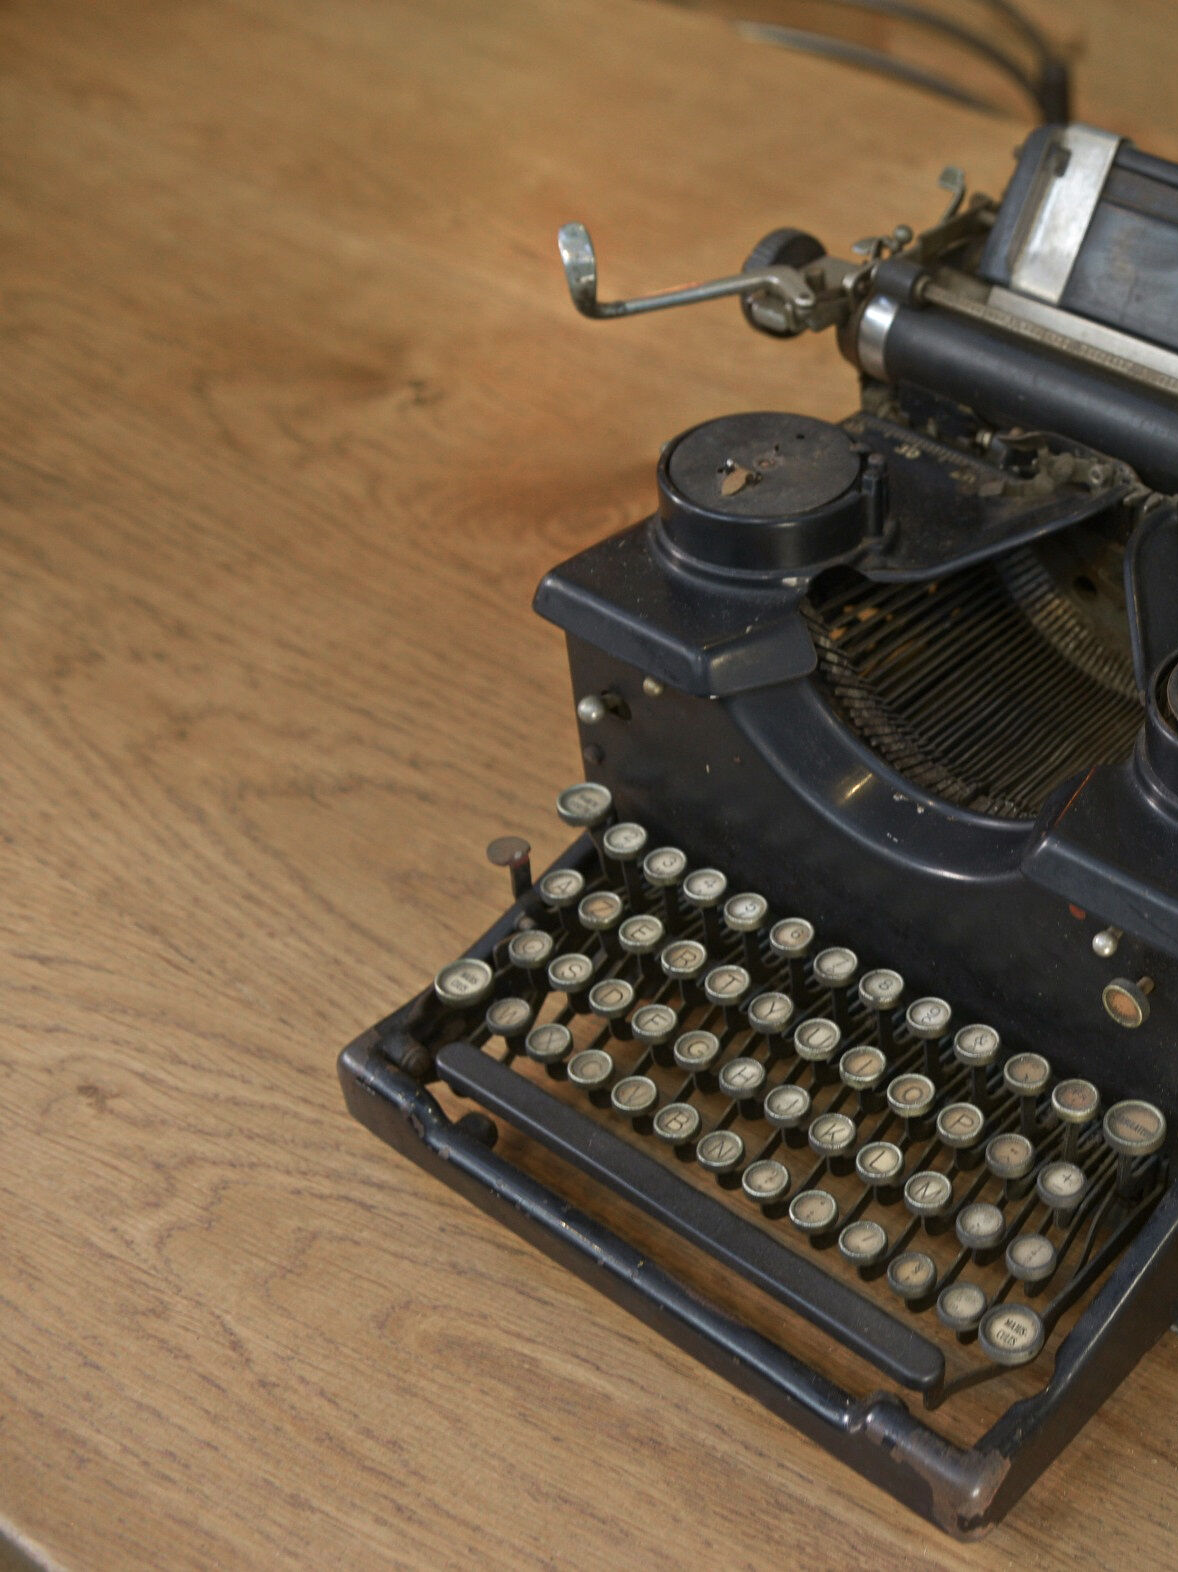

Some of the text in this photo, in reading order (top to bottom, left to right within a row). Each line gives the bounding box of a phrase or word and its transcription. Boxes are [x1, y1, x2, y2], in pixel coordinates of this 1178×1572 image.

[552, 878, 573, 894] A
[630, 923, 655, 940] E
[672, 948, 697, 968] R
[560, 963, 582, 979] S
[718, 973, 742, 993] T
[597, 986, 623, 1006] D
[763, 1000, 786, 1019] Y
[640, 1012, 669, 1028] F
[807, 1026, 833, 1049] U
[688, 1040, 710, 1056] G
[727, 1065, 756, 1088] H
[901, 1086, 925, 1103] O
[776, 1097, 800, 1113] J
[664, 1110, 689, 1130] B
[948, 1112, 975, 1130] P
[819, 1121, 846, 1144] K
[706, 1140, 734, 1160] N
[868, 1149, 886, 1174] L
